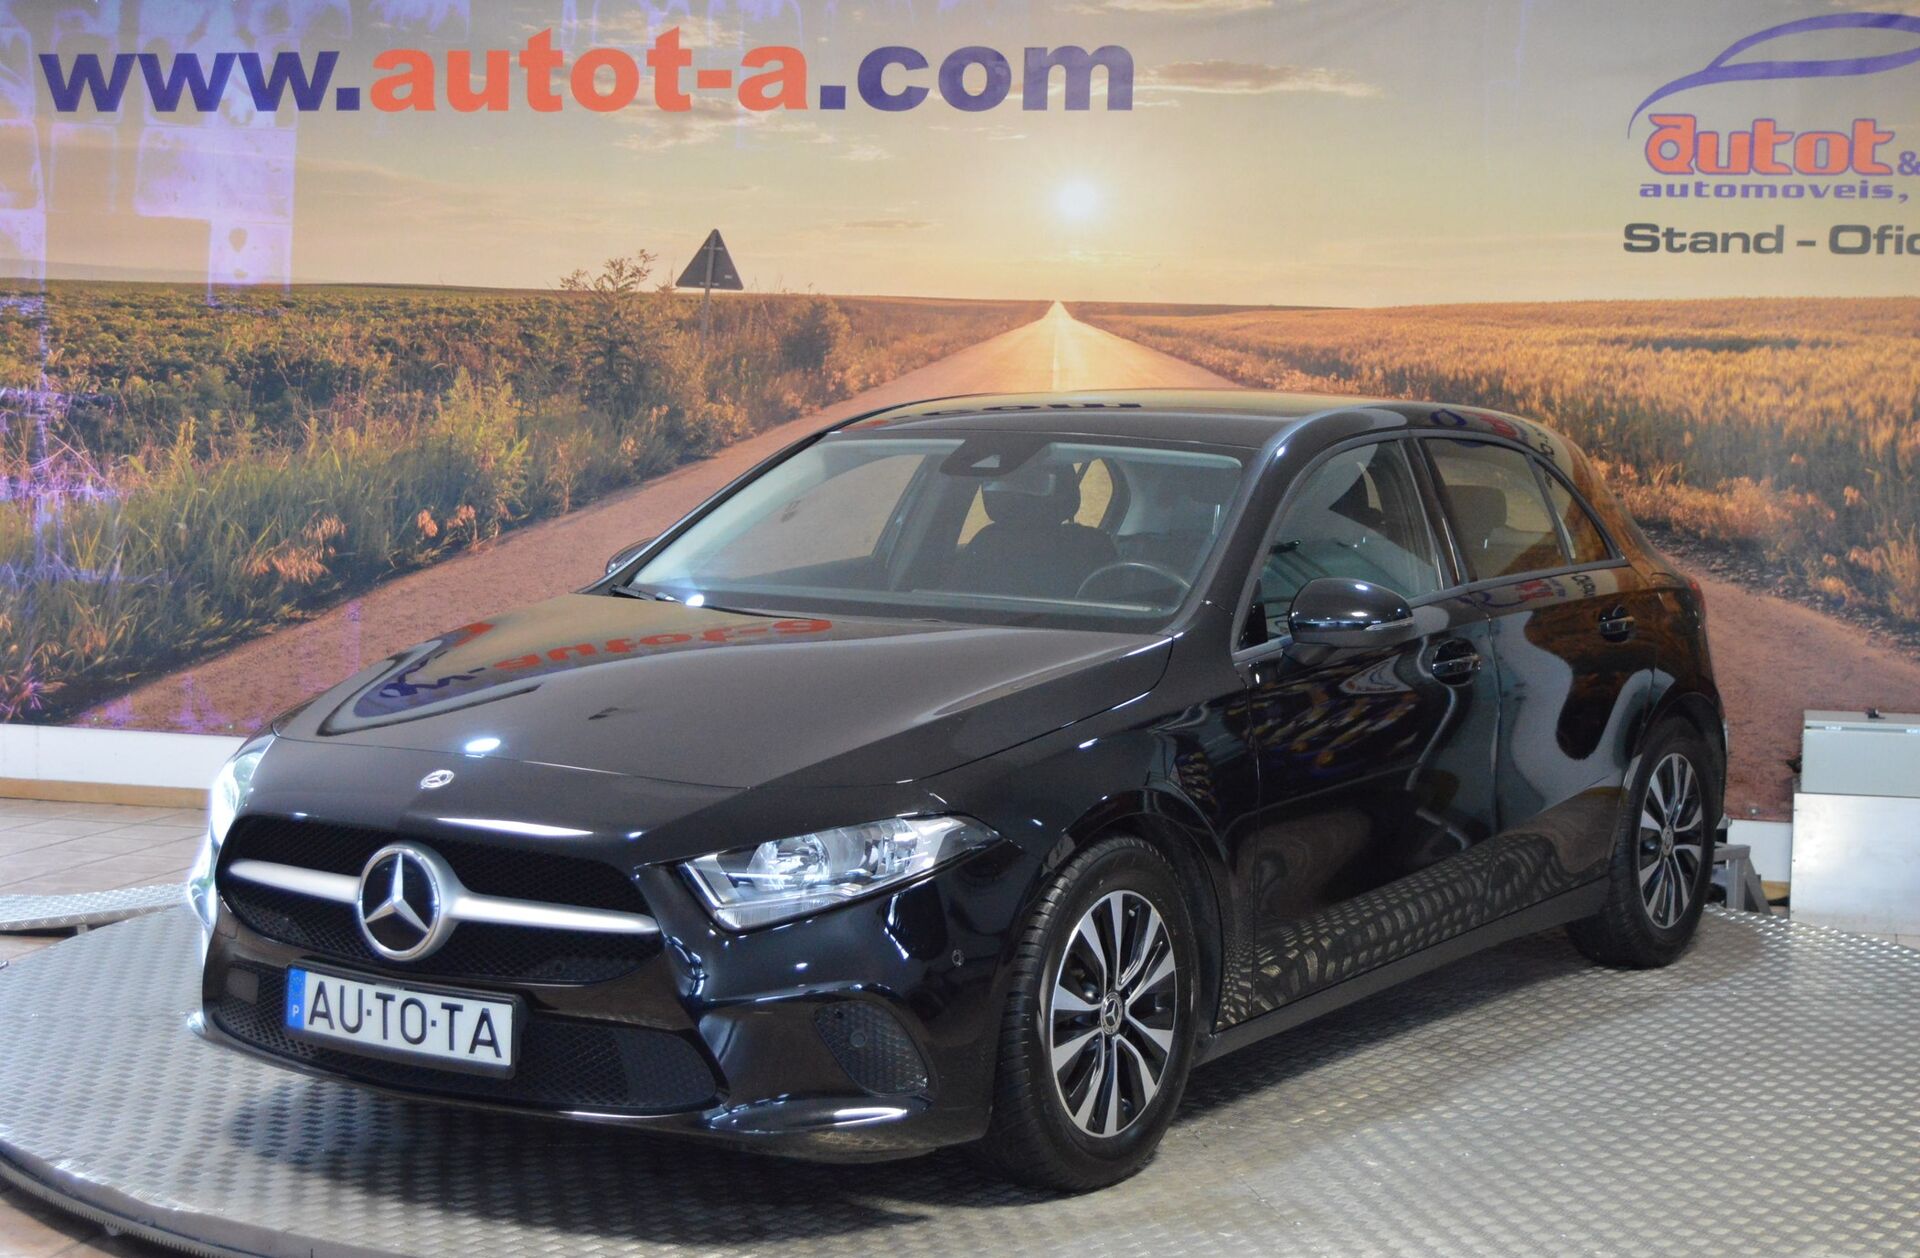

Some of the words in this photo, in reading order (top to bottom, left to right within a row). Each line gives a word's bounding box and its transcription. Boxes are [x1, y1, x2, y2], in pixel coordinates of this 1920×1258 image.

[38, 26, 1134, 112] www.autot-a.com
[1645, 114, 1895, 175] autot
[1623, 223, 1784, 254] Stand
